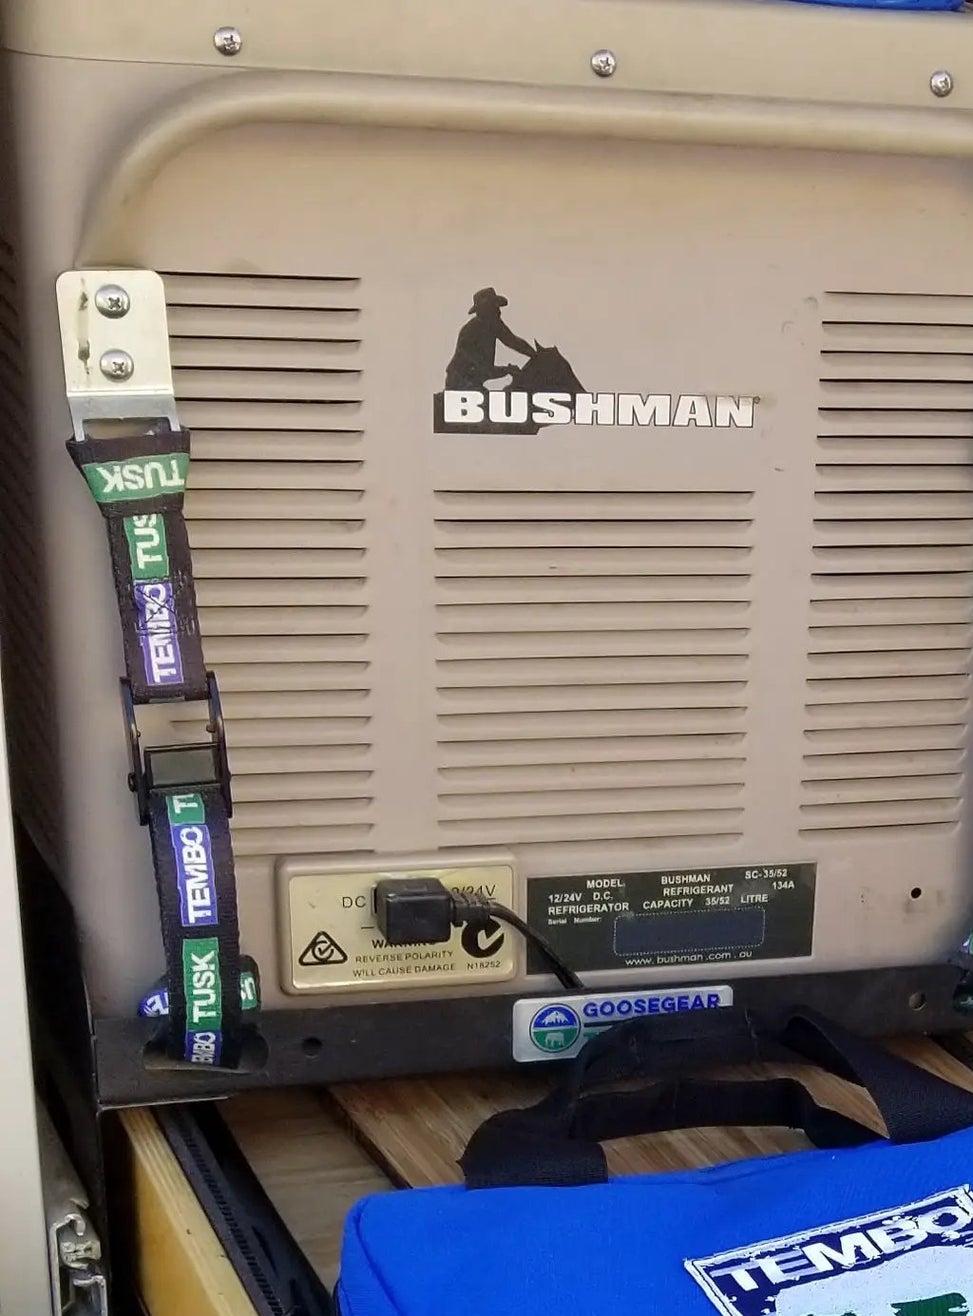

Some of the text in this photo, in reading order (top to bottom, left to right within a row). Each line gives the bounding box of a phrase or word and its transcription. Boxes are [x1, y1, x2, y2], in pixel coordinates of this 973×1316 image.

[443, 390, 755, 428] BUSHMAN
[96, 459, 185, 493] TUSK
[132, 514, 163, 570] TUS
[142, 582, 177, 683] TEMBO
[178, 825, 213, 924] TEMBO
[661, 874, 711, 885] BUSHMAN
[745, 868, 788, 880] SC-35/52
[342, 895, 367, 909] DC
[548, 892, 582, 904] 12/24V
[663, 884, 734, 897] REFRIGERANT
[772, 881, 795, 890] 134A
[548, 894, 769, 916] REFRIGERATOR CAPACITY 35/52 LITRE
[353, 962, 456, 977] WILL CAUSE DAMAGE
[355, 950, 454, 964] REVERSE POLARITY
[190, 948, 217, 1023] TUSK
[583, 993, 721, 1017] GOOSEGEAR
[718, 1206, 973, 1292] TEMBO
